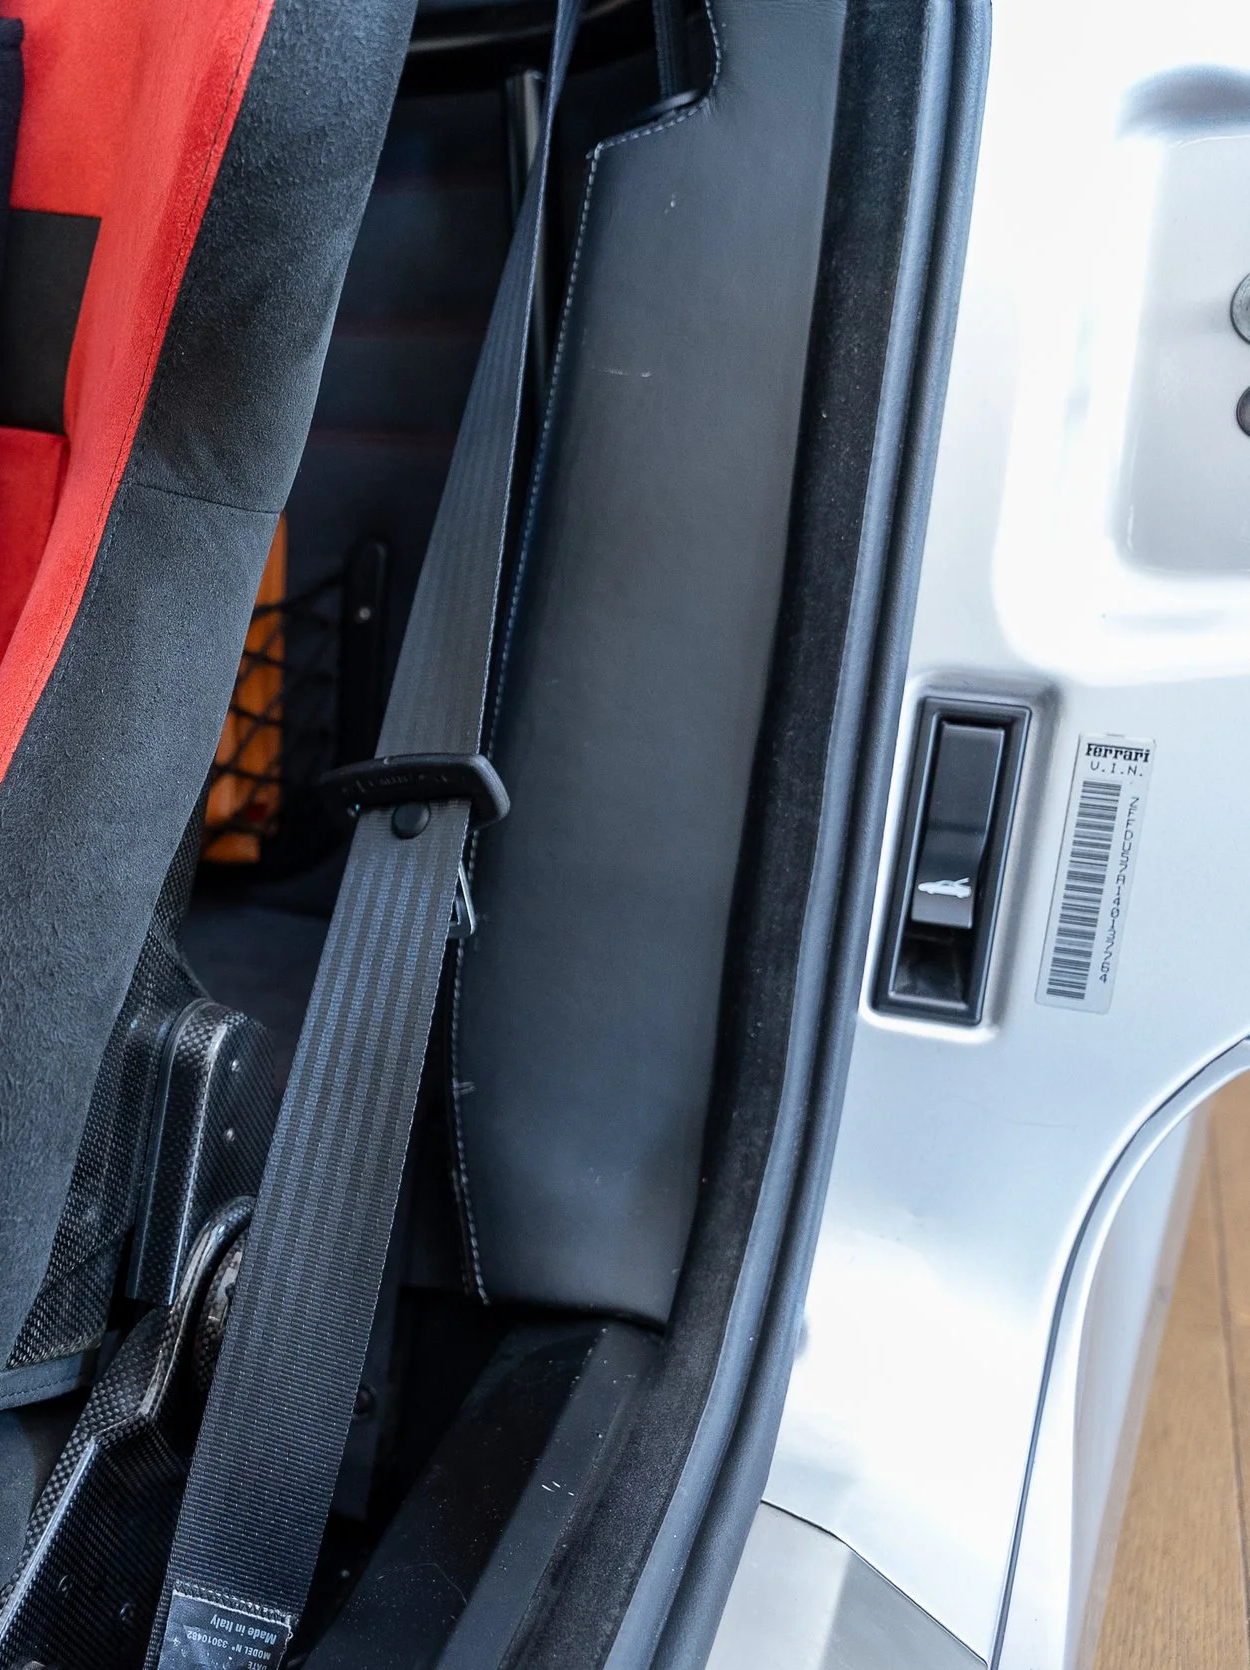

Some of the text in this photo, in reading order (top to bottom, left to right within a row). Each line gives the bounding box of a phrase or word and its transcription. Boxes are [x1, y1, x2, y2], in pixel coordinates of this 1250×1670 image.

[1085, 742, 1150, 763] Ferrari
[210, 1614, 277, 1645] Made in Italy
[245, 1646, 271, 1660] MODEL
